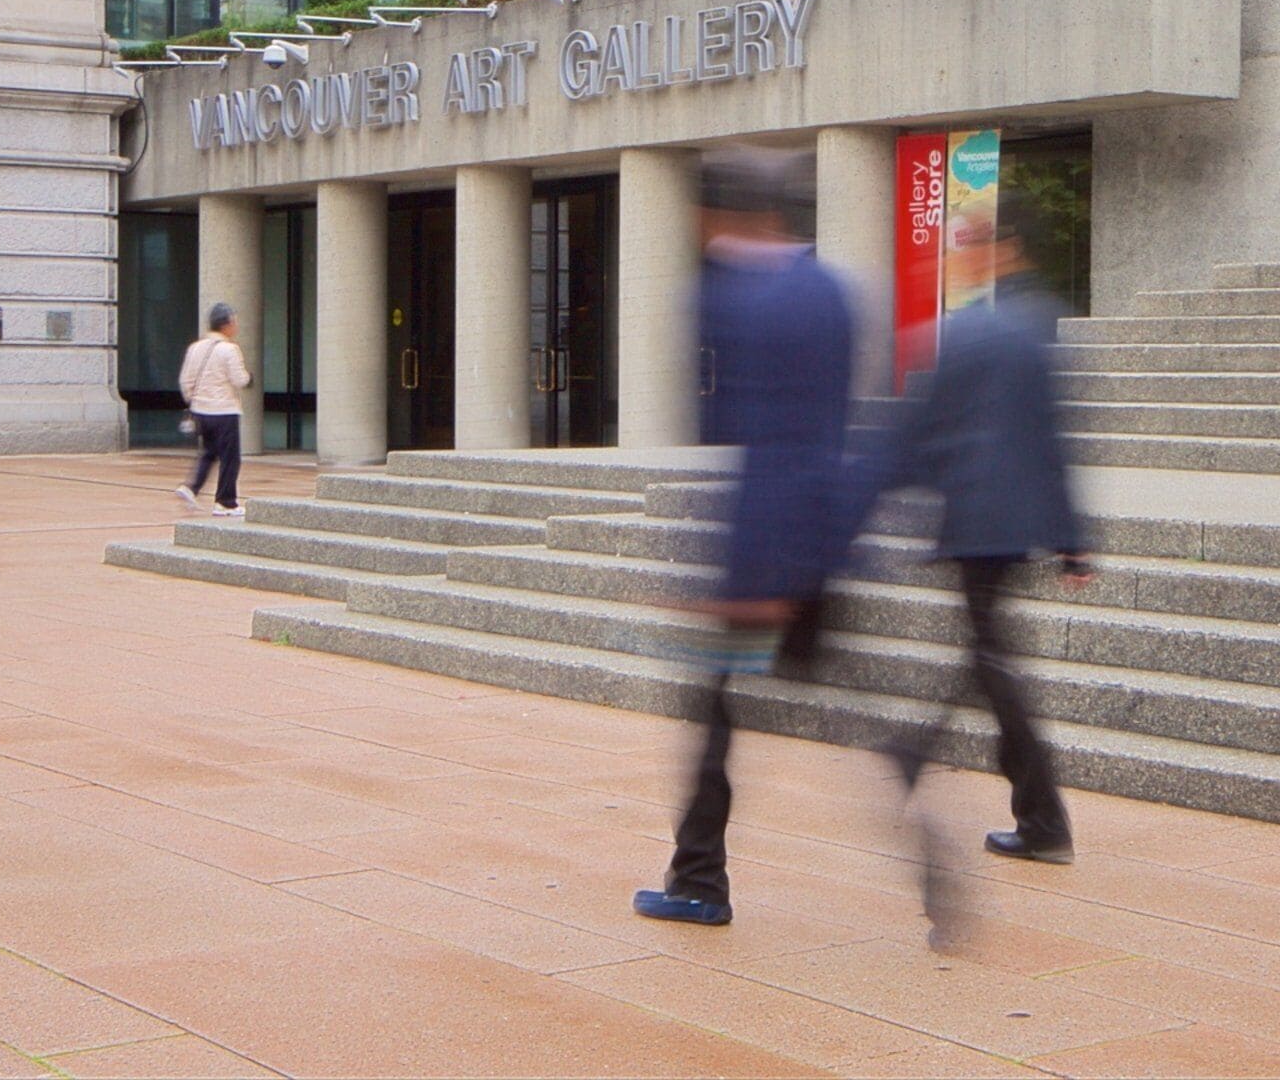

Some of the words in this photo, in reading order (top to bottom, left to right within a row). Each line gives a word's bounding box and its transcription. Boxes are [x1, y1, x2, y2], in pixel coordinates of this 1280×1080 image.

[187, 60, 419, 151] VANCOUVER
[442, 39, 538, 117] ART
[909, 161, 929, 245] gallery
[926, 150, 943, 226] Store
